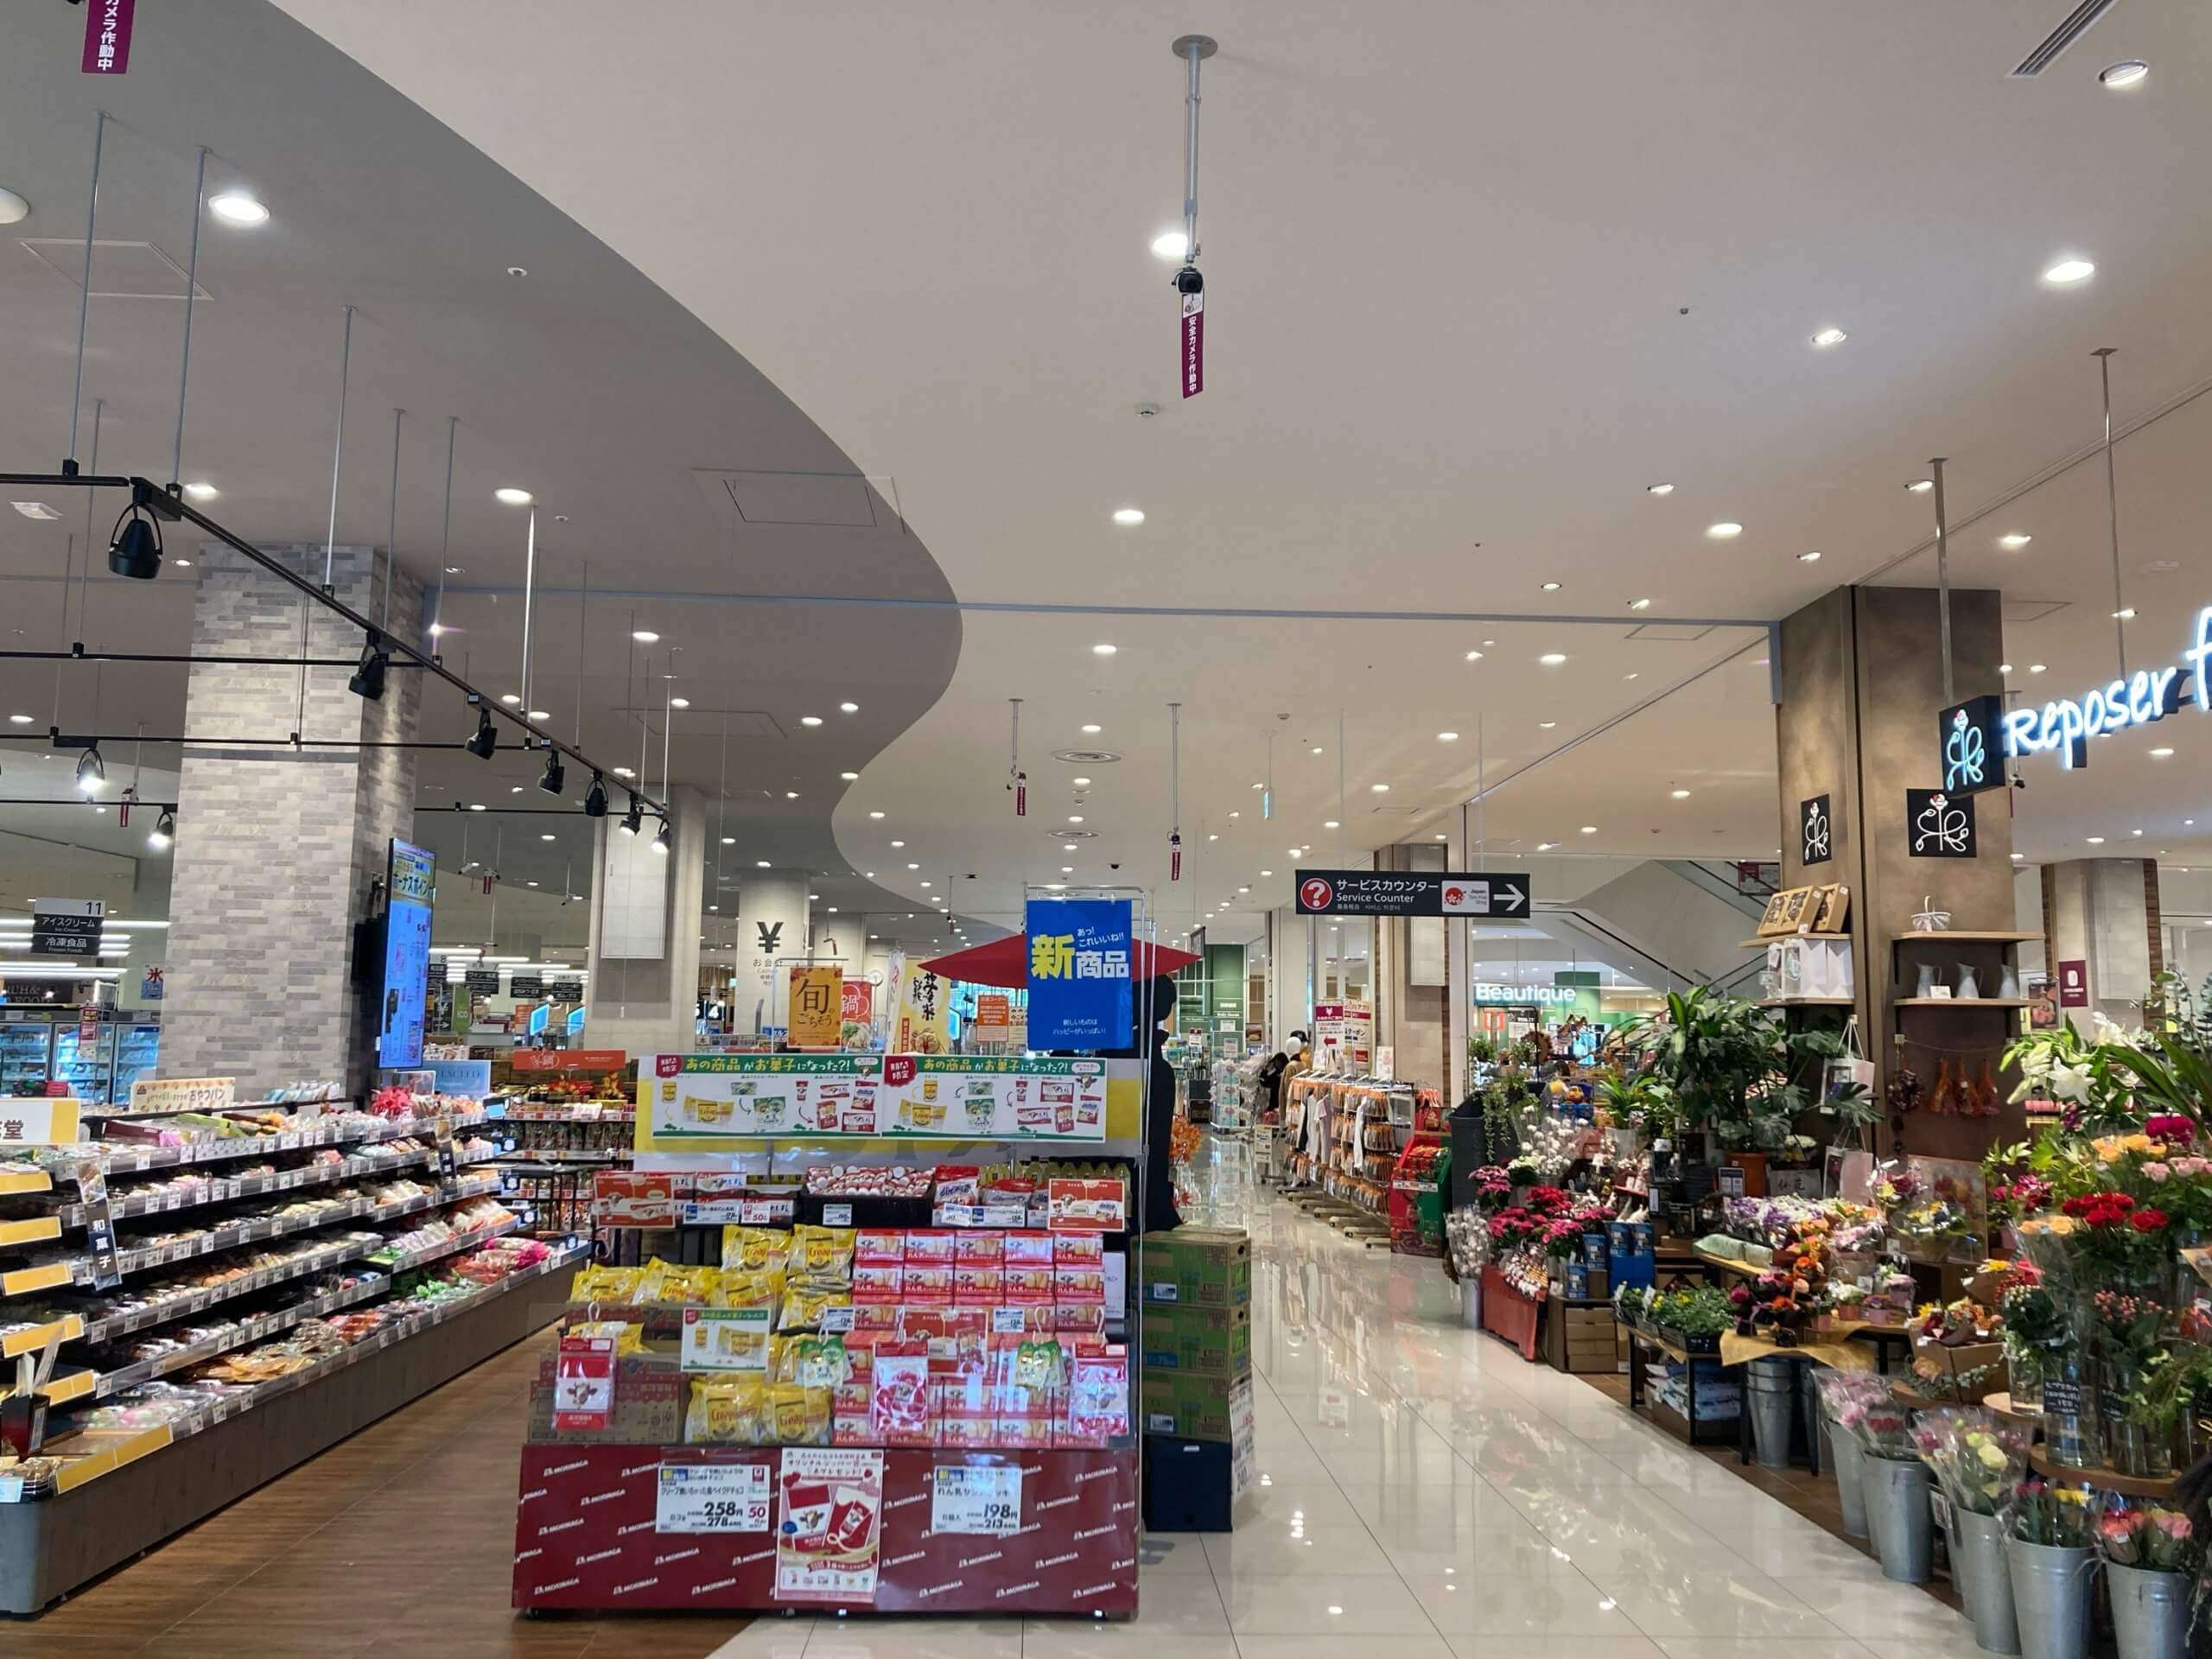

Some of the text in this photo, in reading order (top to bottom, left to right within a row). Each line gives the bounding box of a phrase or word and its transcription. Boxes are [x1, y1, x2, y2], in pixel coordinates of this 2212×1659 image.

[2004, 666, 2177, 770] Reposer
[1337, 880, 1439, 892] サービスカウンター
[1337, 893, 1415, 903] Service Counter
[86, 902, 103, 915] 11
[42, 917, 95, 927] アイスクリーム
[46, 937, 87, 948] 冷凍食品
[1078, 932, 1124, 948] これいいね!!
[1476, 984, 1576, 1004] Beautique
[797, 1014, 833, 1027] ごちそう
[748, 1506, 766, 1518] 50
